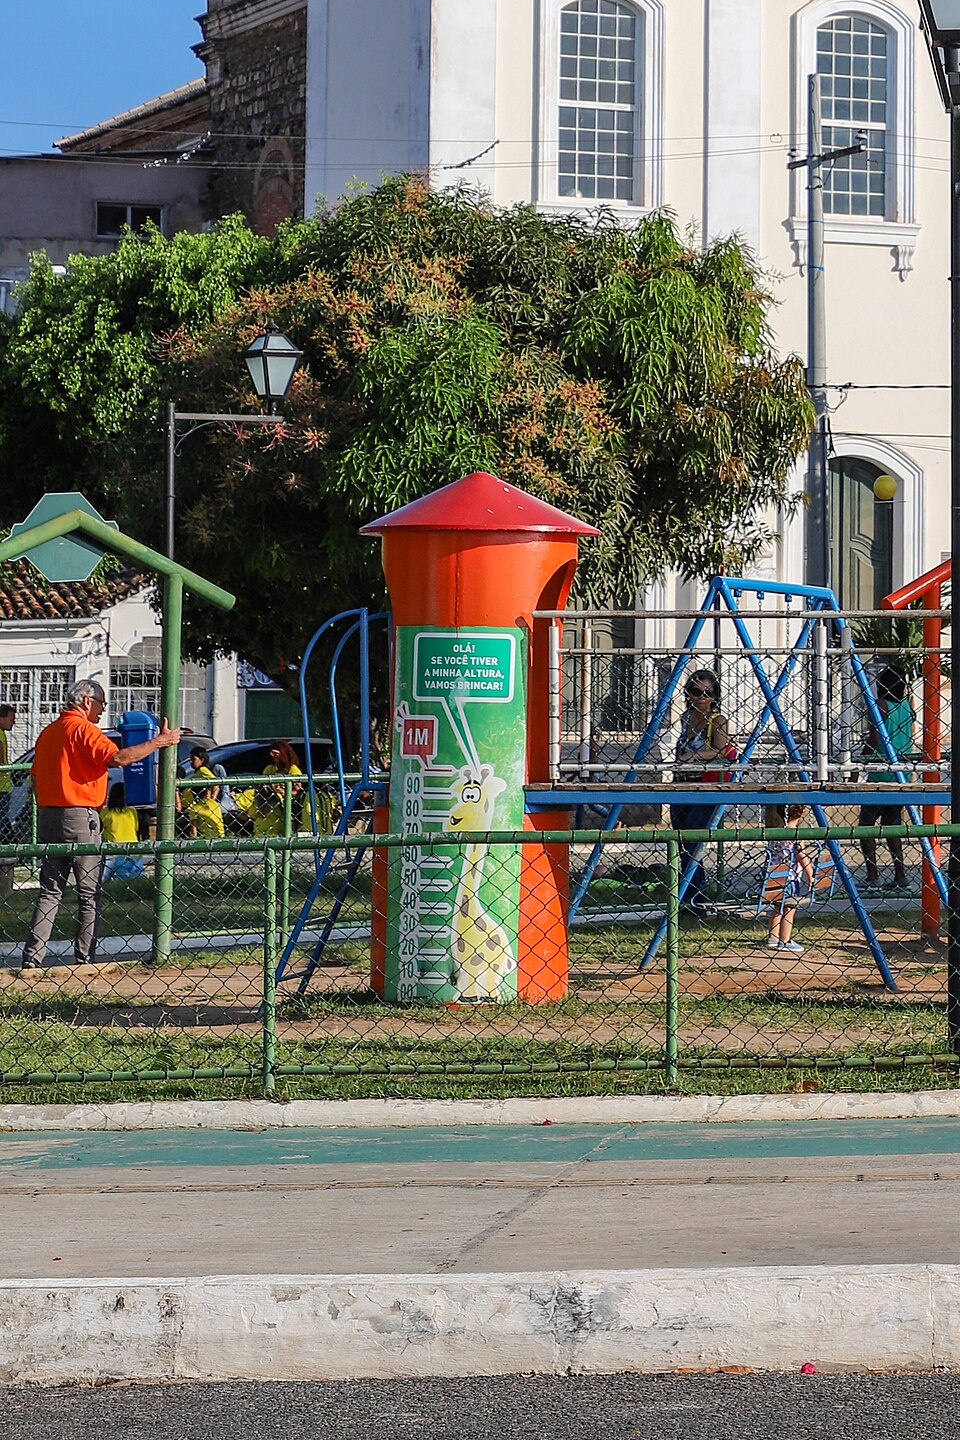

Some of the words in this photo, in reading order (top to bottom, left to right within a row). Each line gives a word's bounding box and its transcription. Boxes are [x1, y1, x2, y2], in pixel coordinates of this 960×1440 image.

[453, 642, 475, 653] OLÁ!
[431, 656, 442, 665] SE
[444, 654, 468, 665] VOCÊ
[470, 656, 498, 666] TIVER
[424, 668, 431, 677] A
[432, 668, 462, 677] MINHA
[463, 669, 505, 679] ALTURA,
[424, 680, 455, 689] VAMOS
[457, 681, 503, 691] BRINCAR!
[406, 728, 429, 746] 1M
[407, 777, 419, 794] 90
[406, 800, 419, 817] 80
[404, 845, 418, 863] 60
[404, 869, 417, 886] 50
[402, 891, 416, 909] 40
[402, 915, 415, 932] 30
[401, 938, 415, 955] 20
[402, 960, 414, 978] 10
